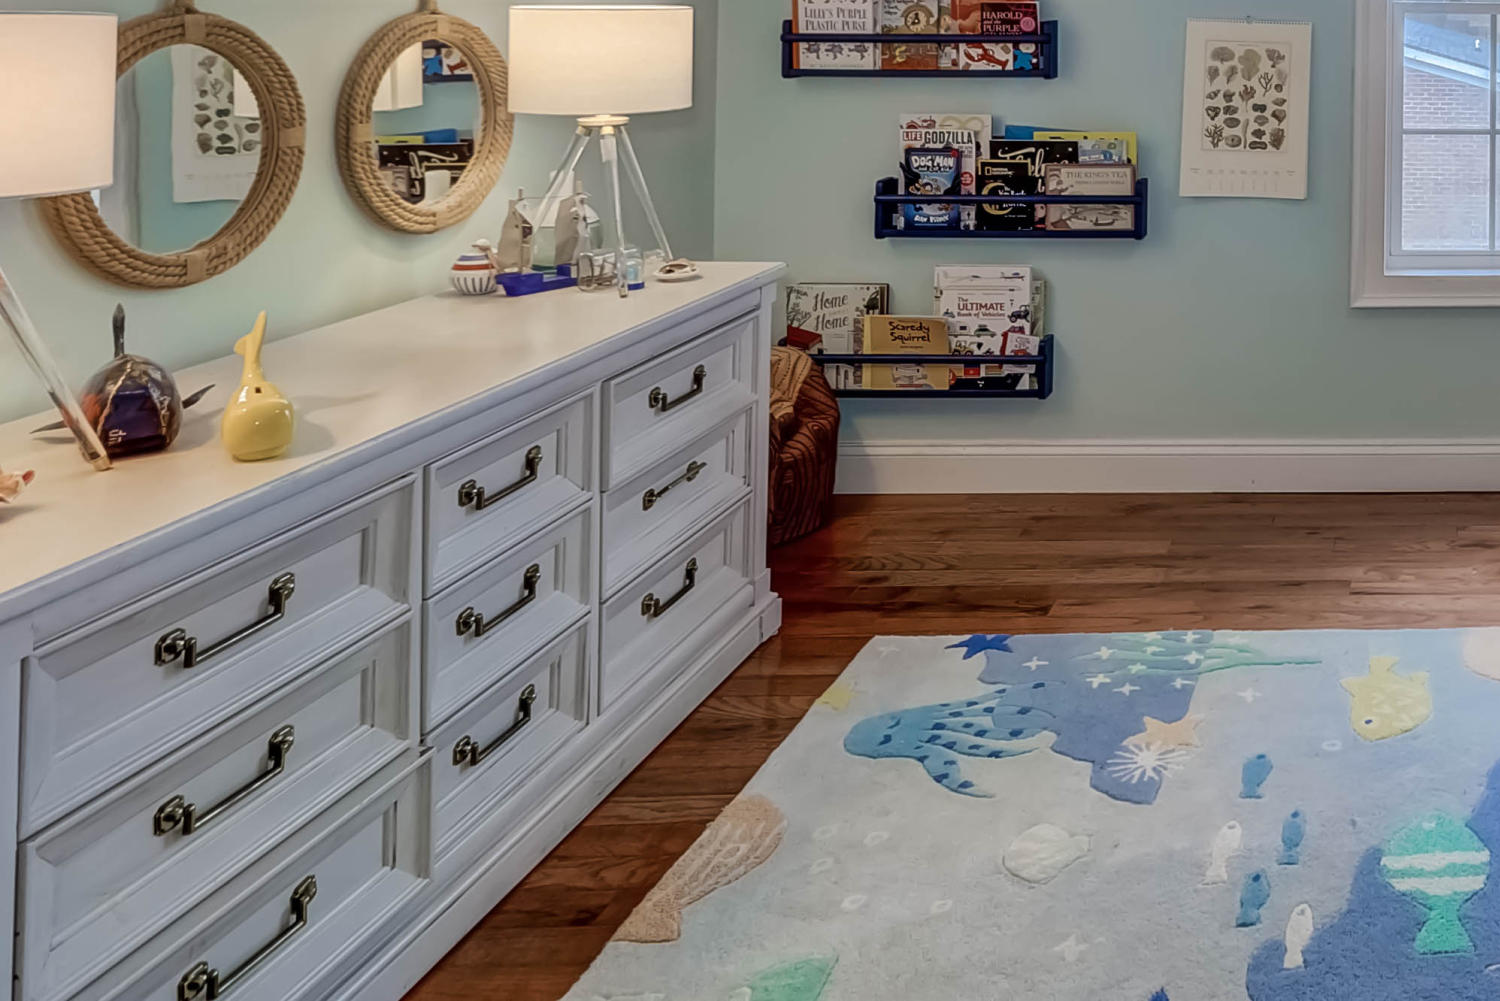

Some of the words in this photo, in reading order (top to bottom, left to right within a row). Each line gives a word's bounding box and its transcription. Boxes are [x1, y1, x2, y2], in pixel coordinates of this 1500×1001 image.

[804, 7, 834, 19] LILLY'S
[836, 7, 867, 19] PURPLE
[982, 11, 1023, 20] HAROLD
[805, 20, 837, 31] PLASTIC
[839, 20, 867, 31] PURSE
[983, 24, 1020, 32] PURPLE
[904, 131, 921, 141] LIFE
[924, 131, 973, 145] GODZILLA
[911, 155, 932, 168] DOG
[934, 155, 954, 168] MAN
[1066, 171, 1082, 179] THE
[1112, 171, 1128, 179] TEA
[812, 291, 849, 312] Home
[957, 302, 1005, 311] ULTIMATE
[815, 313, 849, 332] Home
[888, 321, 930, 334] Scaredy
[889, 331, 931, 344] Squirrel
